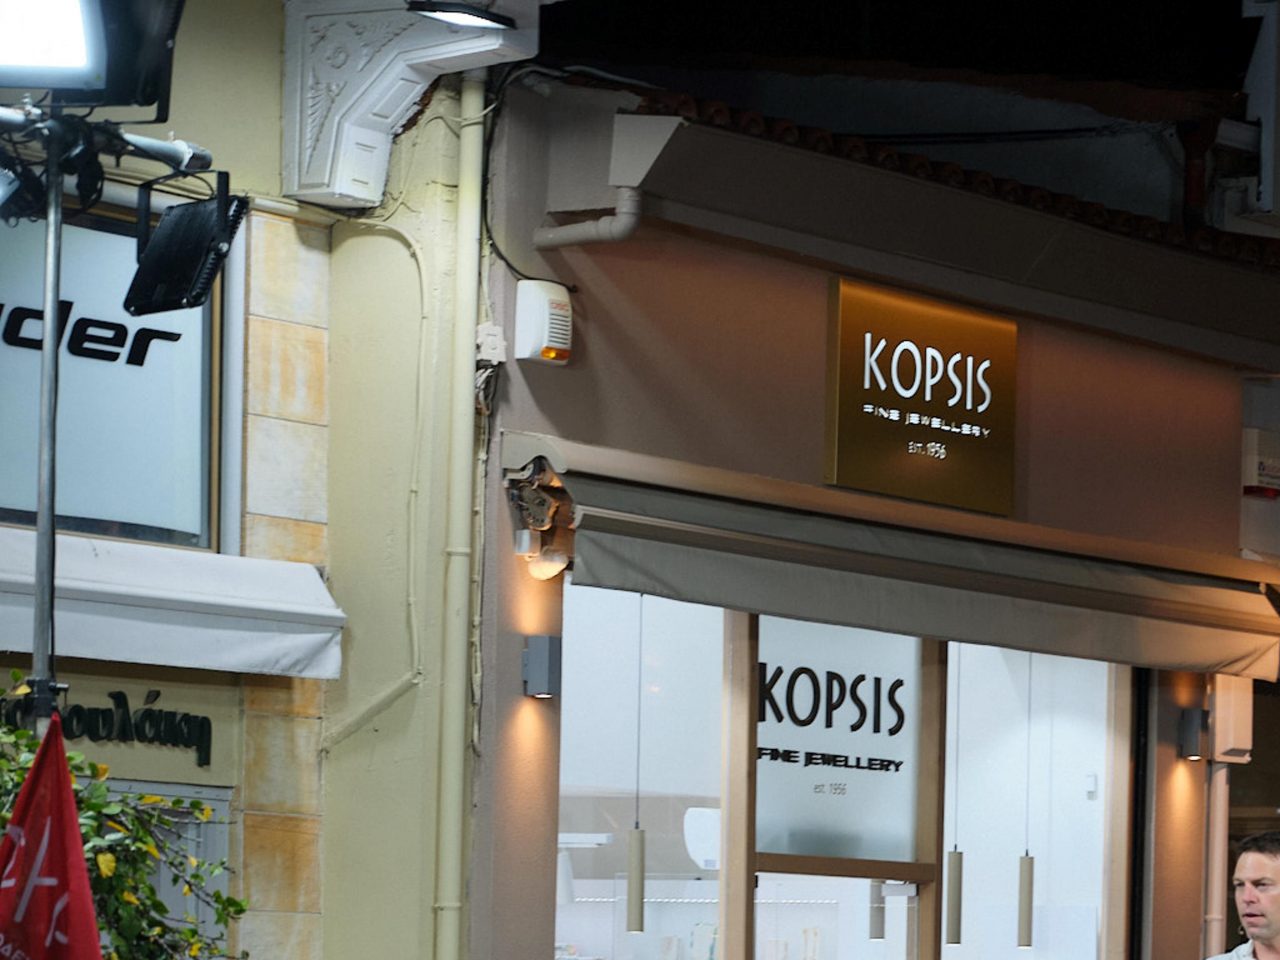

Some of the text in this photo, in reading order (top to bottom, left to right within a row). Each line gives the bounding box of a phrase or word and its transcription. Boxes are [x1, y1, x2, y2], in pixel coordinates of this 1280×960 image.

[0, 300, 182, 367] der
[863, 332, 992, 413] KOPSIS
[864, 405, 991, 437] FINE JEWELLERY
[757, 662, 905, 737] KOPSIS
[757, 746, 904, 772] FINE JEWELLERY
